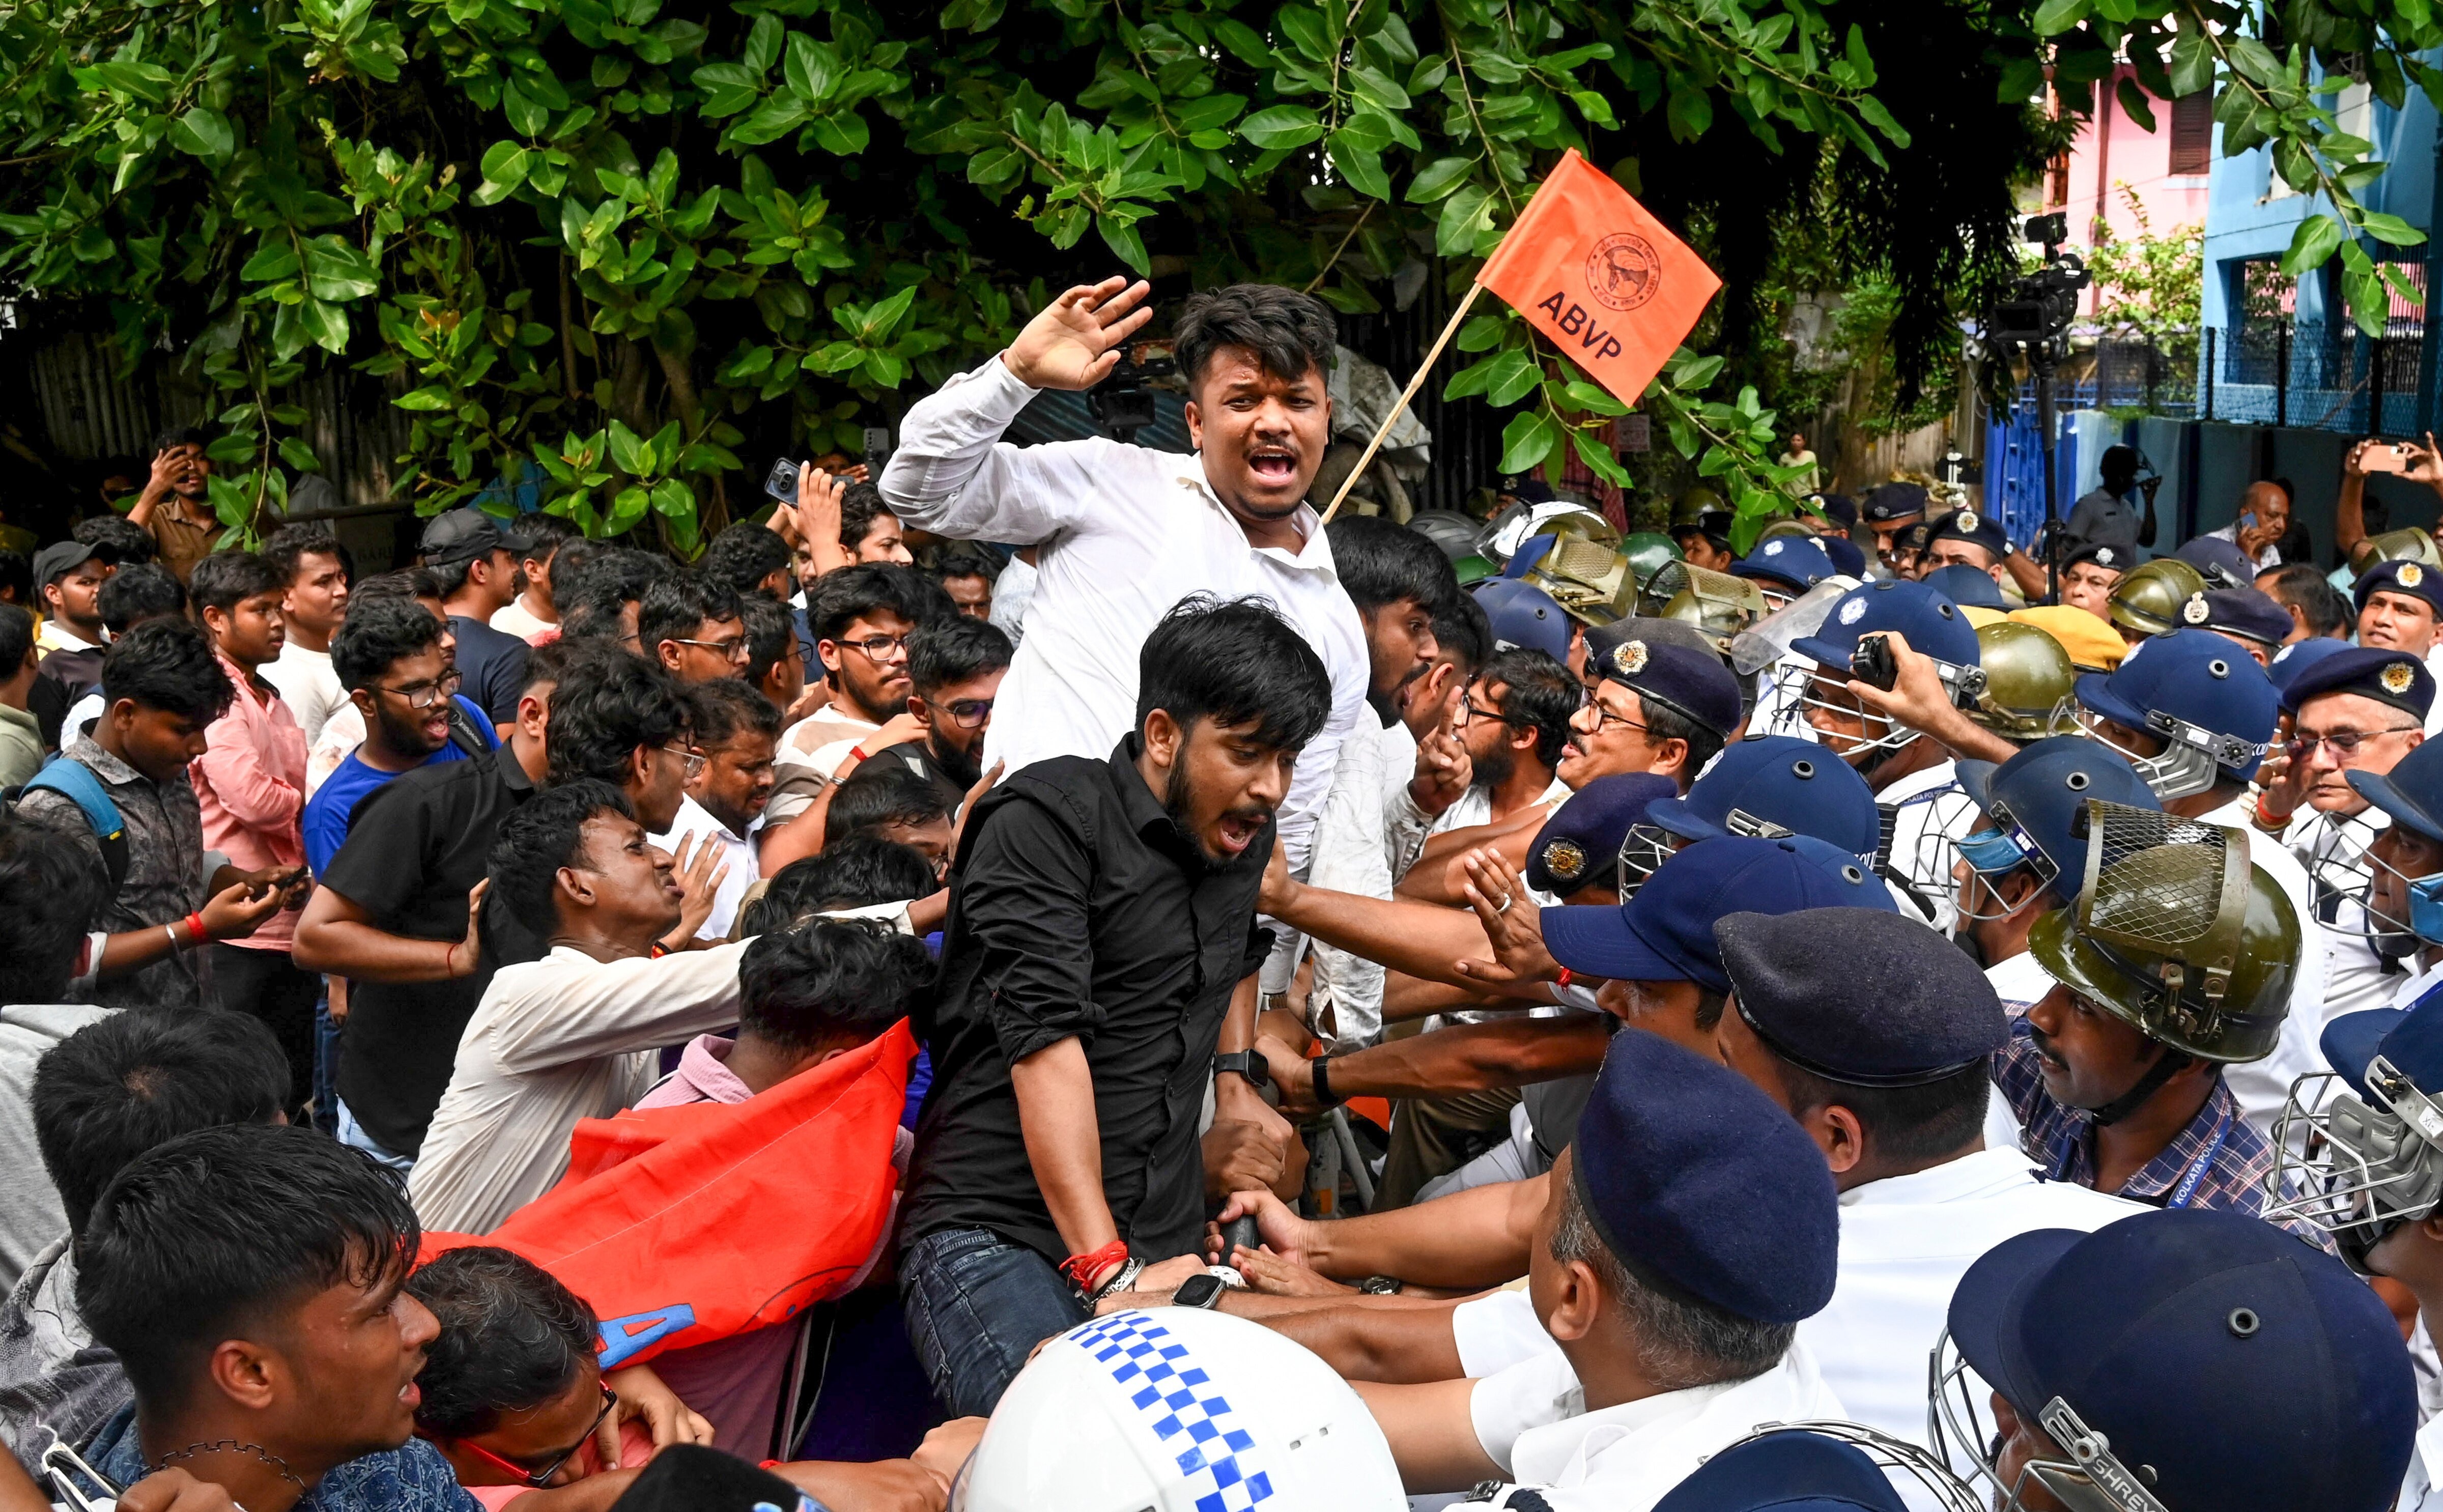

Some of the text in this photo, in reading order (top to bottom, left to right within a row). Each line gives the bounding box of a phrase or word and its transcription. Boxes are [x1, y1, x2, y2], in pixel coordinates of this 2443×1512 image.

[1538, 291, 1622, 359] ABVP
[2174, 1131, 2222, 1204] KOLKATA POLICE
